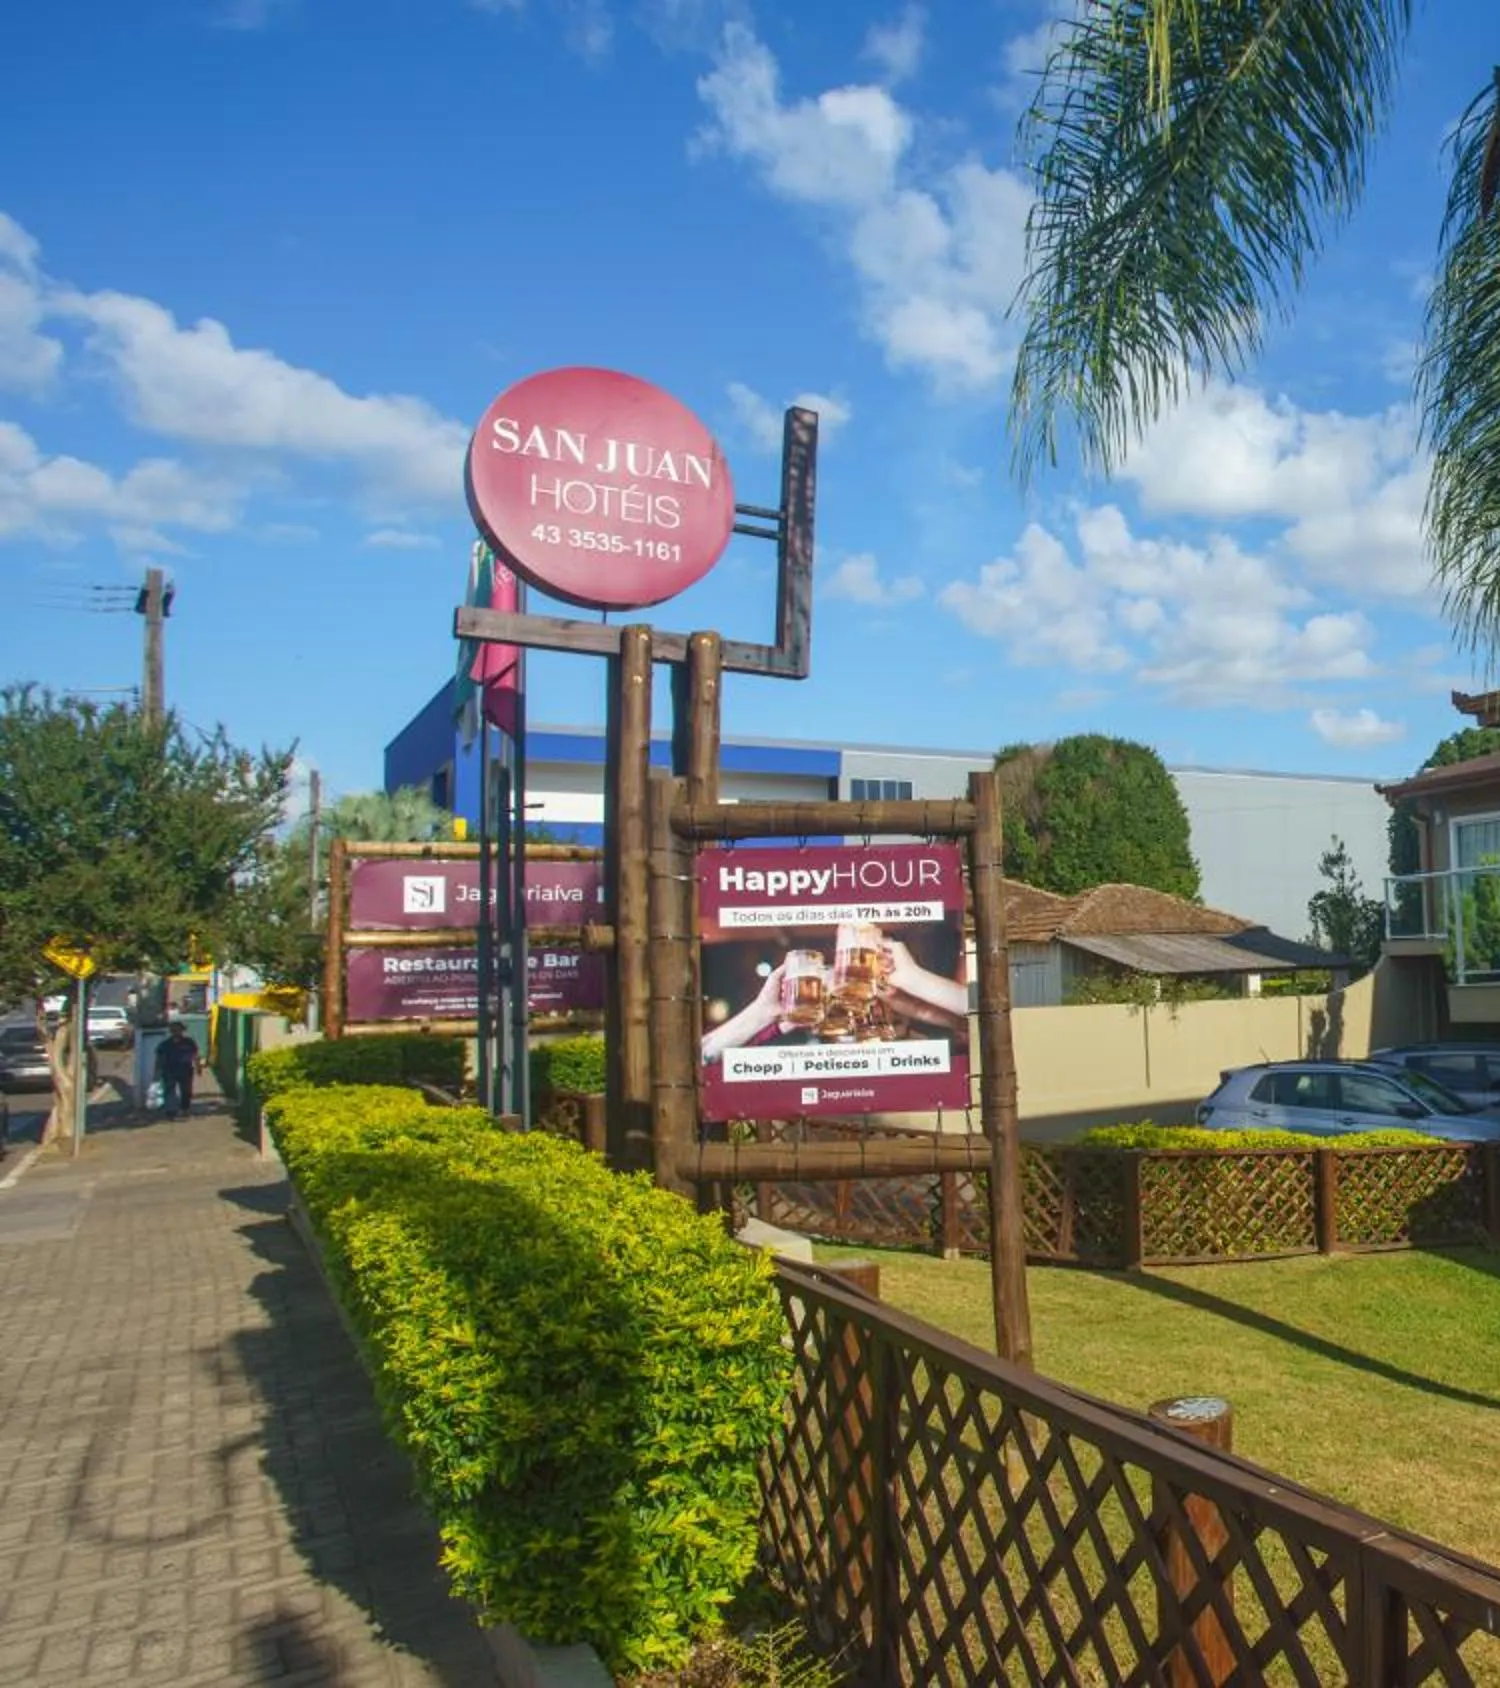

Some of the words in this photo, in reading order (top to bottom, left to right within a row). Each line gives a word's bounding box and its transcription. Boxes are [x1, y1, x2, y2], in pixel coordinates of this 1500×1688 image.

[492, 417, 587, 464] SAN
[596, 438, 715, 489] JUAN
[530, 473, 681, 530] HOTÉIS
[531, 523, 561, 545] 43
[568, 531, 681, 562] 3535-1161
[455, 882, 584, 905] Jagriaíva
[856, 906, 881, 918] 17h
[904, 904, 932, 917] 20h
[383, 956, 520, 973] Restaura
[543, 953, 579, 967] Bar
[733, 1062, 783, 1075] Chopp
[804, 1058, 869, 1072] Petiscos
[890, 1054, 941, 1068] Drinks
